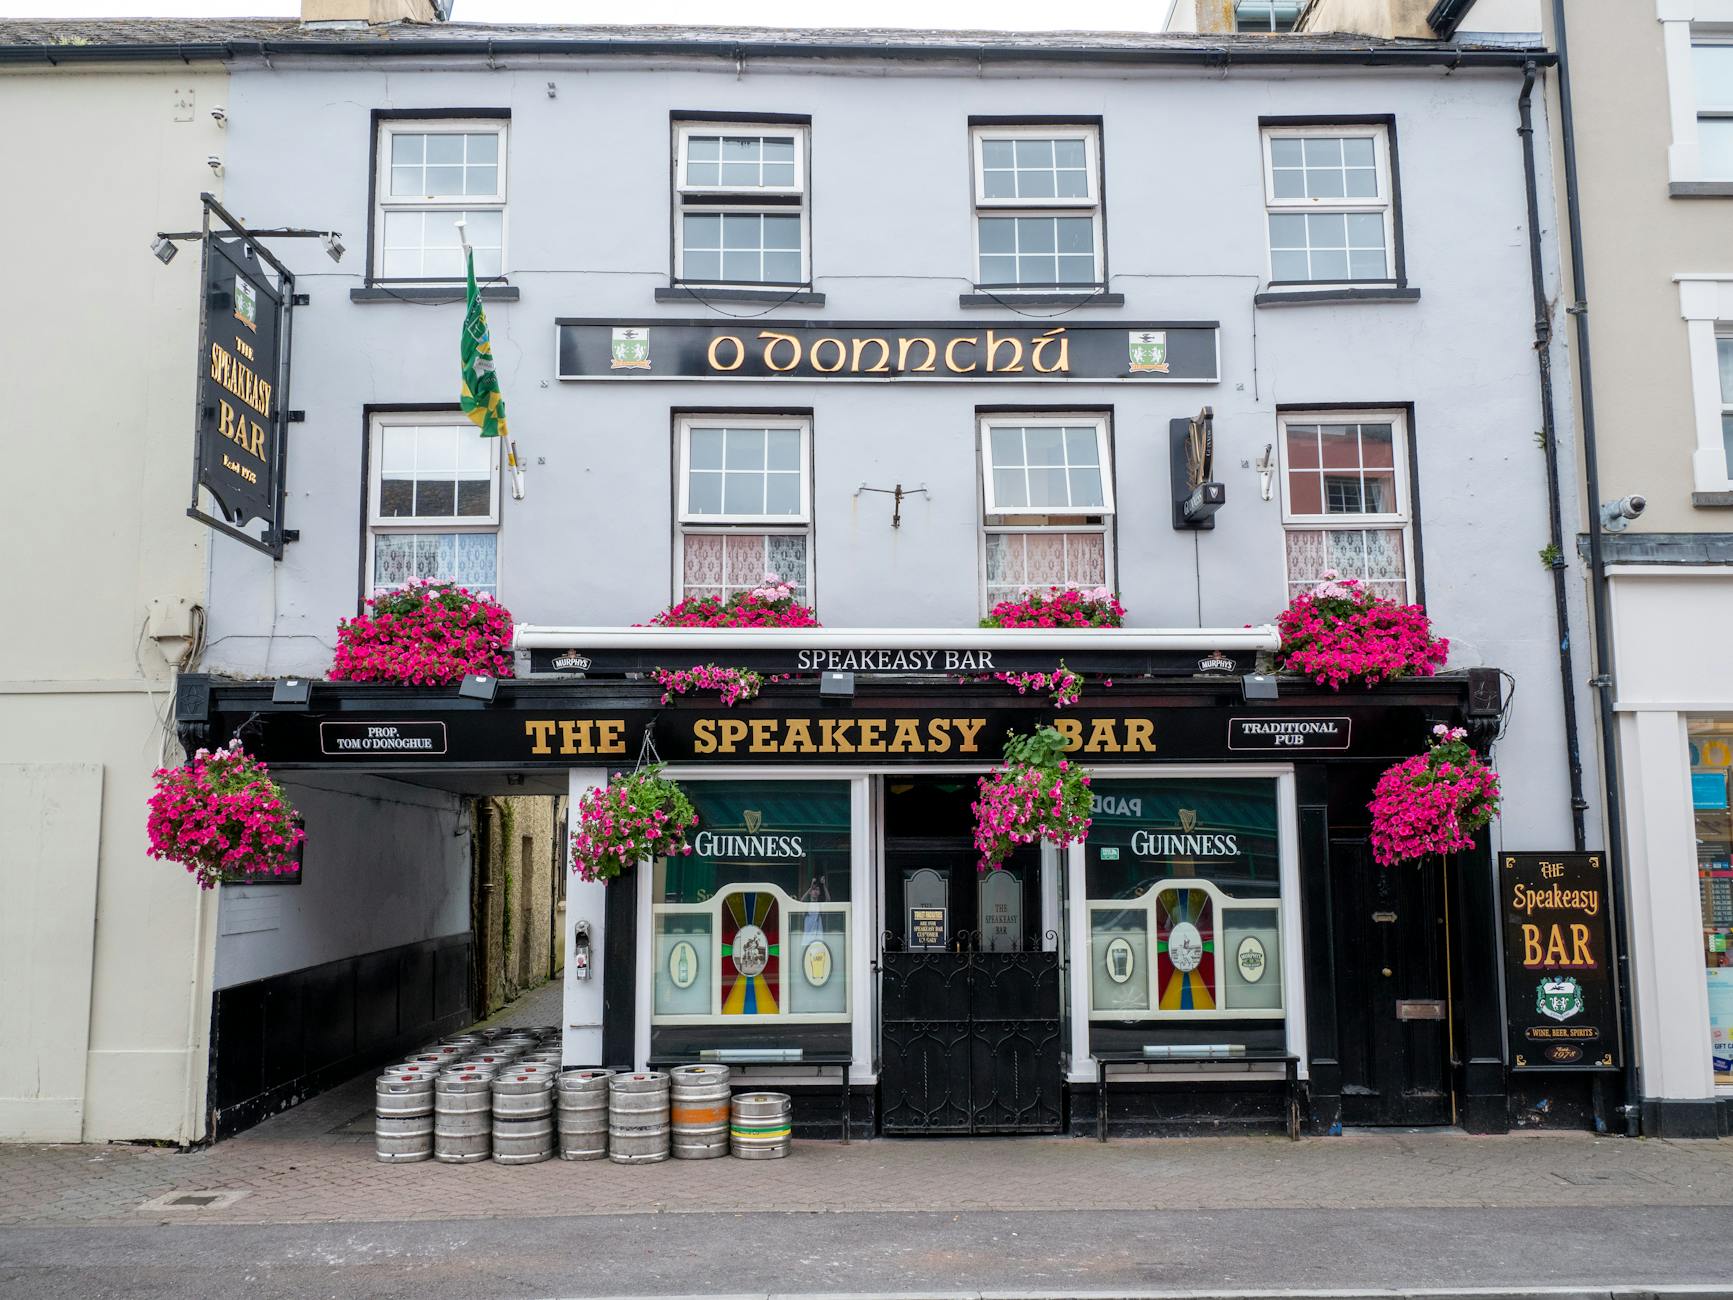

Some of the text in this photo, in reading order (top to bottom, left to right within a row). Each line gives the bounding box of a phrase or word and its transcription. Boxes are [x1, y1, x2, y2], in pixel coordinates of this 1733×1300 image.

[235, 336, 254, 361] THE
[211, 342, 272, 419] SPEAKEASY
[218, 398, 267, 462] BAR
[797, 649, 995, 670] SPEAKEASY BAR
[367, 727, 400, 738] PROP.
[525, 718, 1157, 755] THE SPEAKEASY BAR
[1242, 723, 1338, 734] TRADITIONAL
[1274, 735, 1304, 745] PUB
[337, 739, 361, 749] TOM
[695, 831, 802, 858] GUINNESS
[1131, 830, 1238, 856] GUINNESS
[1539, 862, 1565, 878] THE
[995, 904, 1008, 912] THE
[1513, 883, 1599, 915] Speakeasy
[985, 914, 1017, 924] SPEAKEASY
[1522, 923, 1597, 969] BAR
